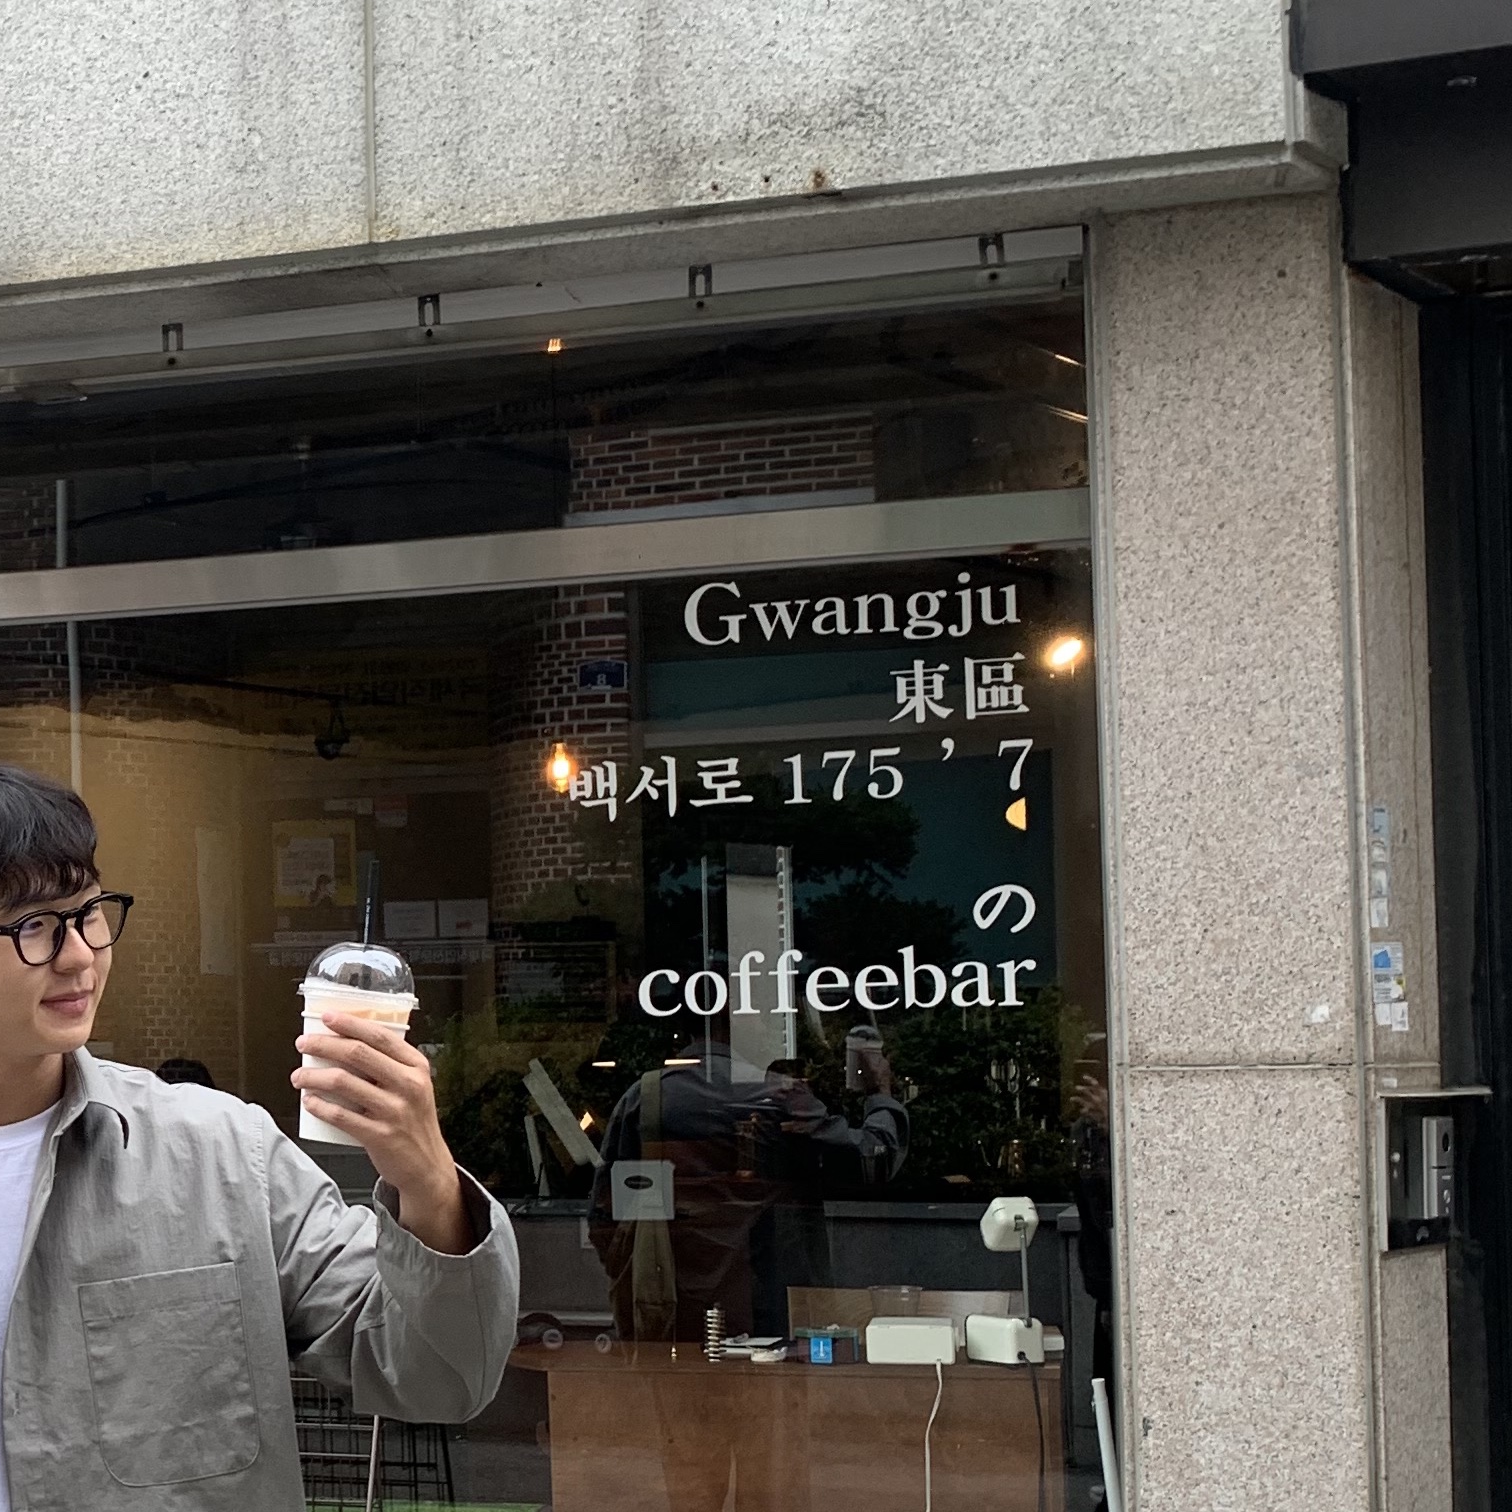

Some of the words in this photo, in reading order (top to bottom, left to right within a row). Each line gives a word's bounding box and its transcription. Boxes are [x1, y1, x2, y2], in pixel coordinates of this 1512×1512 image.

[684, 572, 1021, 645] Gwangju
[889, 652, 1030, 724] 東區
[569, 755, 754, 822] 백서로
[783, 747, 904, 804] 175
[998, 738, 1033, 791] 7
[972, 884, 1036, 933] の
[638, 945, 1037, 1017] coffeebar
